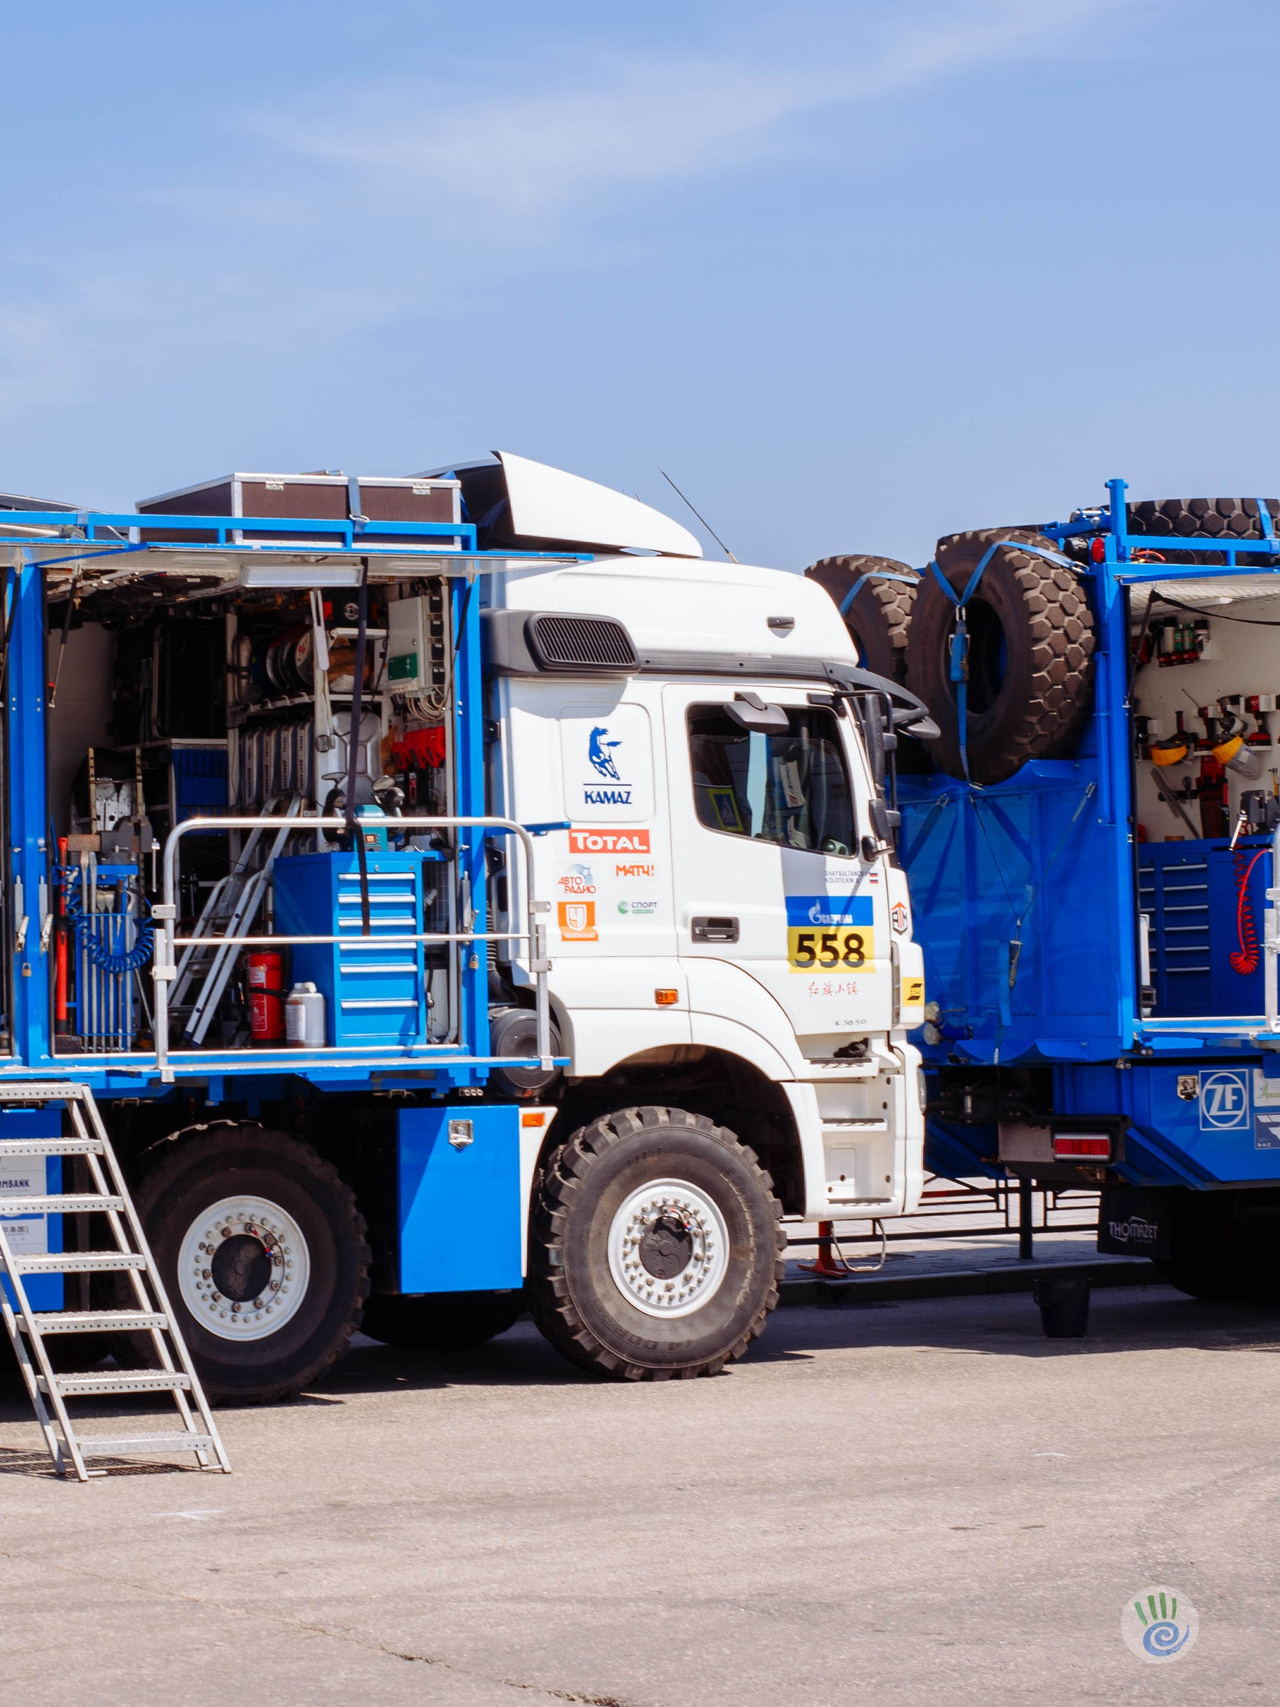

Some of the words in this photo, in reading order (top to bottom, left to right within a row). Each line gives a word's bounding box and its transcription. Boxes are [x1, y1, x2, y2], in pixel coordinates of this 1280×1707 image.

[584, 791, 633, 805] KAMAZ
[571, 832, 648, 850] TOTAL
[615, 864, 654, 877] МАТЧ!
[557, 876, 583, 885] АВТО
[564, 885, 596, 894] РАДИО
[631, 901, 658, 909] СПОРТ
[795, 933, 865, 968] 558
